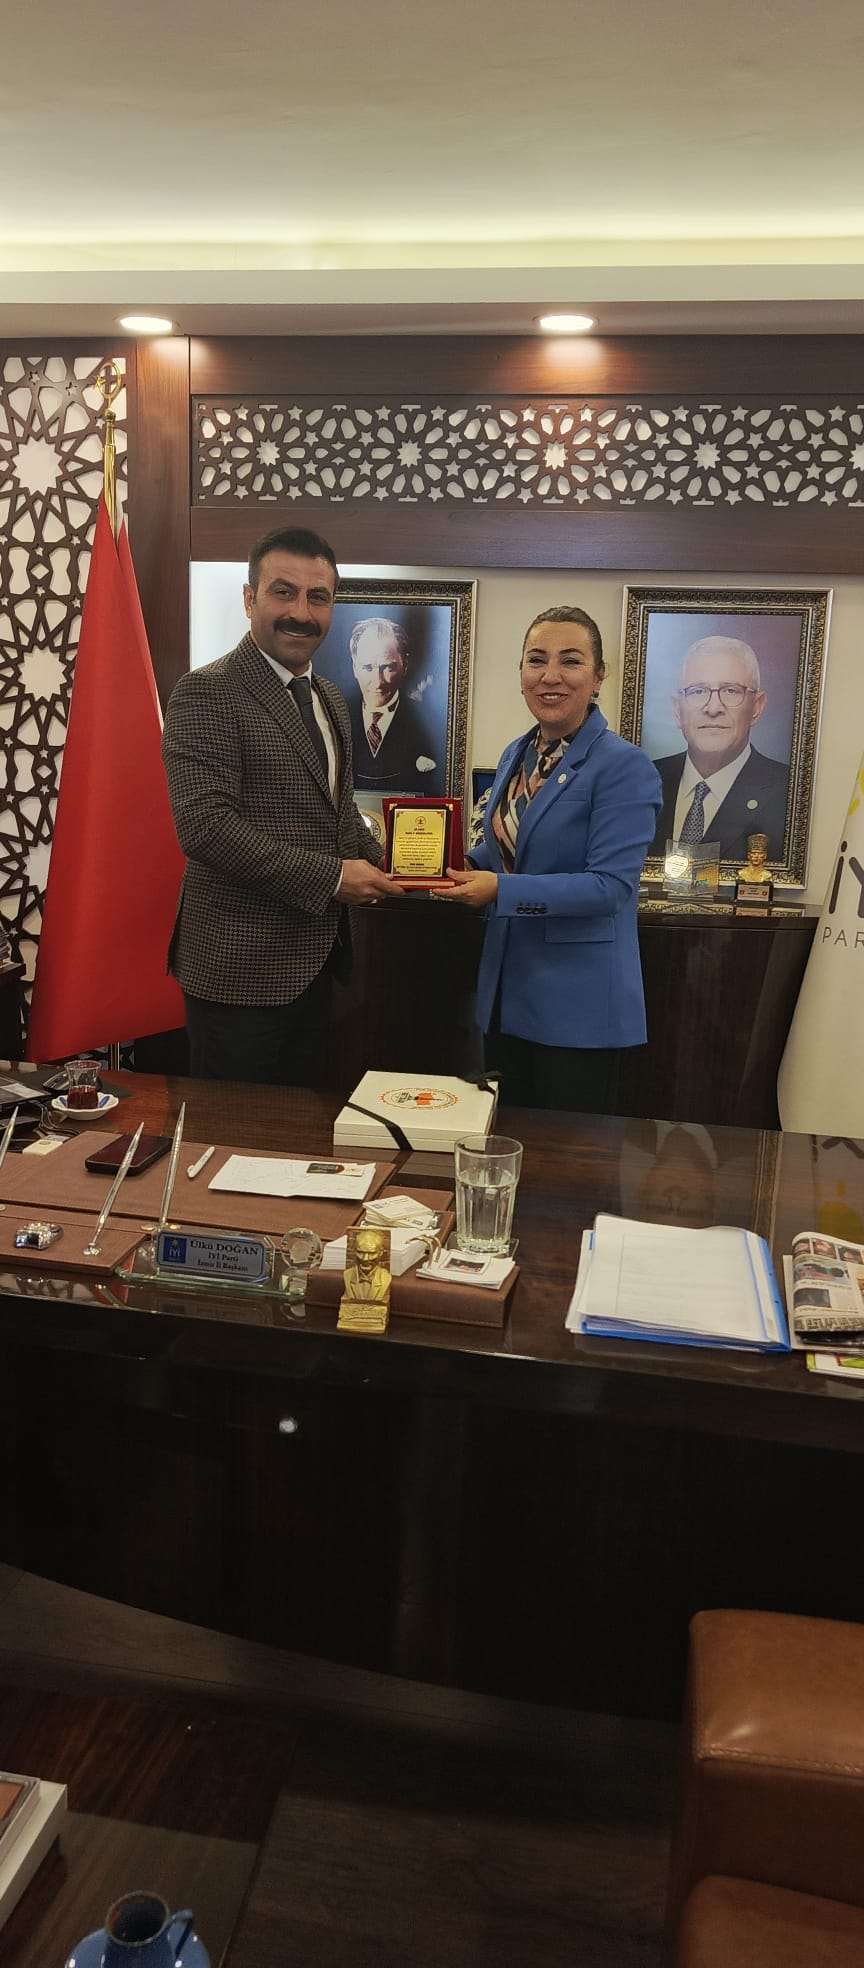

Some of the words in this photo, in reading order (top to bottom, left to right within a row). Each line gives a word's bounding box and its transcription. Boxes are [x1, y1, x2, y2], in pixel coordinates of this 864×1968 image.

[190, 1239, 213, 1250] Ülkü
[216, 1242, 259, 1255] DOĞAN
[222, 1253, 239, 1262] Parti
